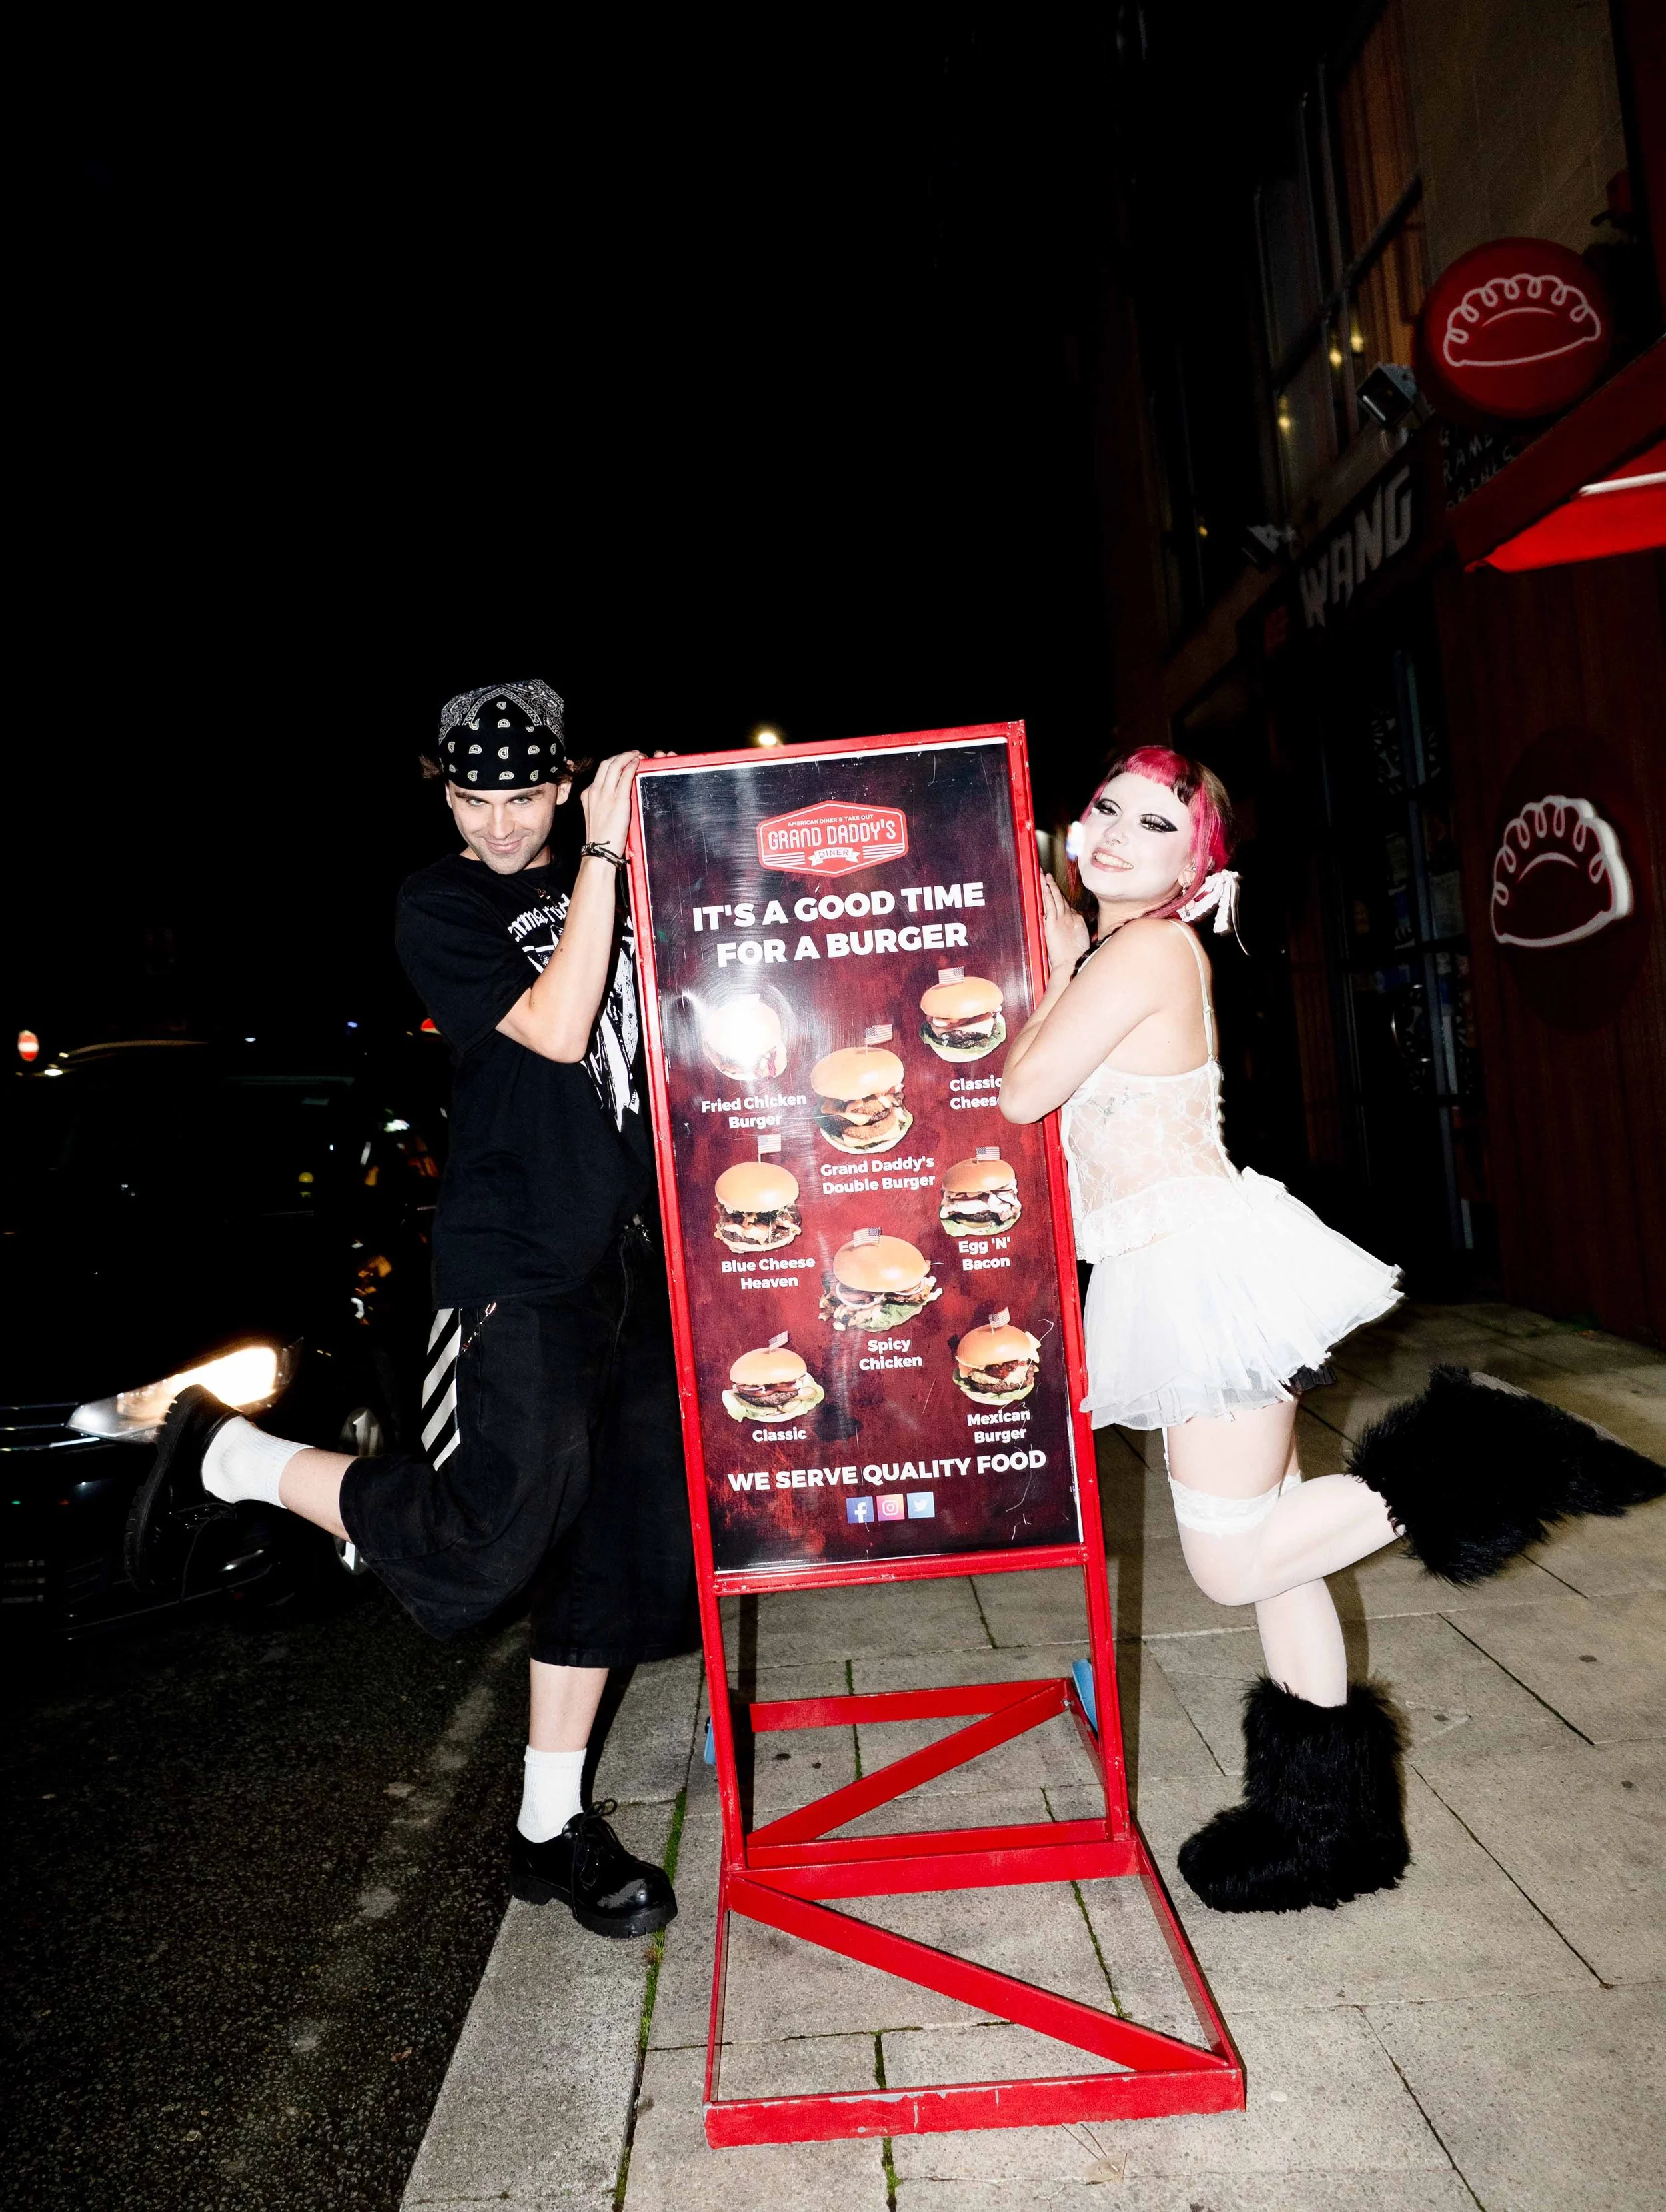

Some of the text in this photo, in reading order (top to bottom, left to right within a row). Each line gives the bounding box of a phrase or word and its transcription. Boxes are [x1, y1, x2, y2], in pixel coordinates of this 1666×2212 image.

[1298, 464, 1413, 630] WANG
[787, 819, 820, 828] AMERICAN
[768, 818, 896, 850] GRAND DADDY'S
[819, 849, 849, 858] DINER
[692, 882, 986, 932] IT'S A GOOD TIME
[717, 922, 969, 968] FOR A BURGER
[949, 1074, 1002, 1092] Classic
[701, 1094, 807, 1113] Fried Chicken
[950, 1096, 1000, 1110] Chees
[728, 1114, 782, 1129] Burger
[820, 1155, 935, 1177] Grand Daddy's
[822, 1174, 936, 1195] Double Burger
[958, 1237, 1011, 1257] Egg 'N'
[721, 1256, 816, 1274] Blue Cheese
[962, 1254, 1010, 1272] Bacon
[740, 1276, 799, 1290] Heaven
[867, 1337, 912, 1355] Spicy
[858, 1354, 923, 1371] Chicken
[967, 1408, 1031, 1426] Mexican
[752, 1426, 807, 1442] Classic
[974, 1427, 1027, 1444] Burger
[728, 1450, 1046, 1492] WE SERVE QUALITY FOOD
